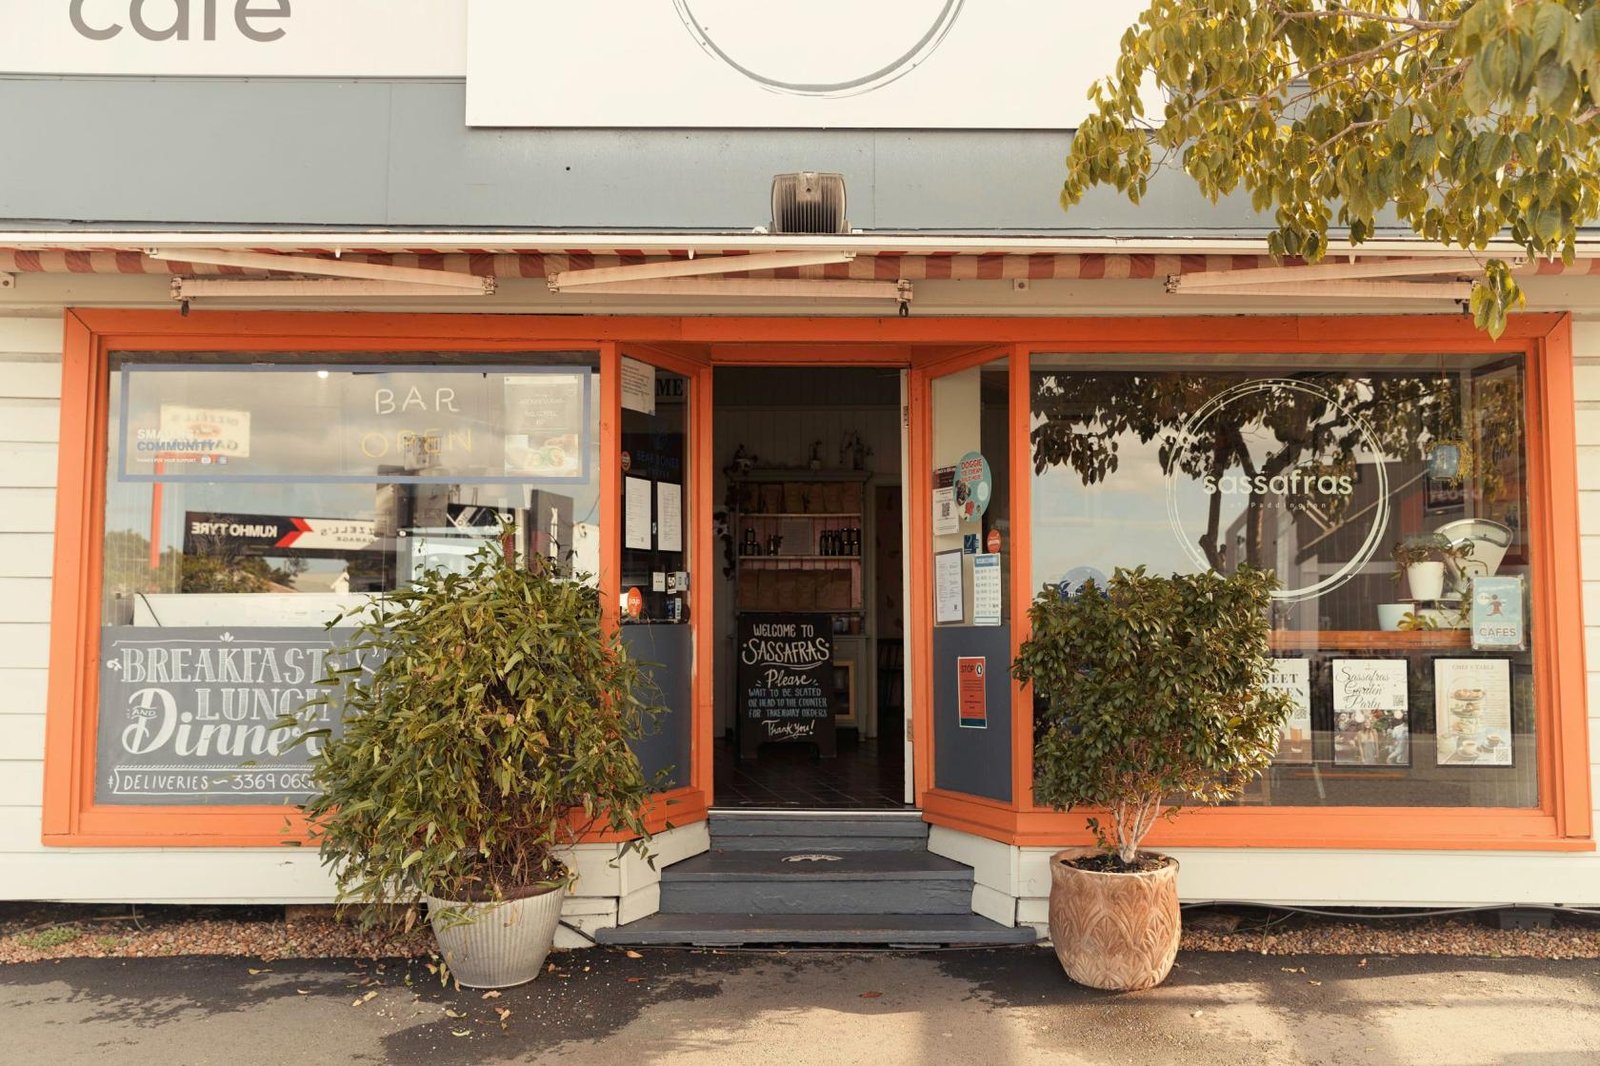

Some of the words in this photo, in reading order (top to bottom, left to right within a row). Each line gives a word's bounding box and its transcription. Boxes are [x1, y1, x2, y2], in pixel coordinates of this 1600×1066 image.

[375, 385, 460, 415] BAR
[137, 440, 215, 451] COMMUNITY
[360, 427, 472, 458] OPEN
[1203, 469, 1353, 495] sassafras
[1251, 503, 1326, 511] Paddington
[753, 624, 796, 637] WELCOME
[801, 624, 814, 638] TO
[1479, 627, 1517, 637] CAFES
[742, 637, 830, 665] SASSAFRAS
[121, 647, 329, 683] BREAKFAST
[961, 664, 975, 673] STOP
[764, 668, 812, 689] Please
[748, 688, 767, 697] WAIT
[769, 688, 779, 697] TO
[782, 687, 792, 697] BE
[794, 687, 822, 697] SEATED
[195, 688, 332, 722] LUNCH
[798, 697, 828, 707] COUNTER
[132, 708, 156, 717] AND
[762, 719, 793, 736] Thank
[124, 774, 208, 790] DELIVERIES
[231, 773, 275, 790] 3369
[280, 773, 315, 789] 060
